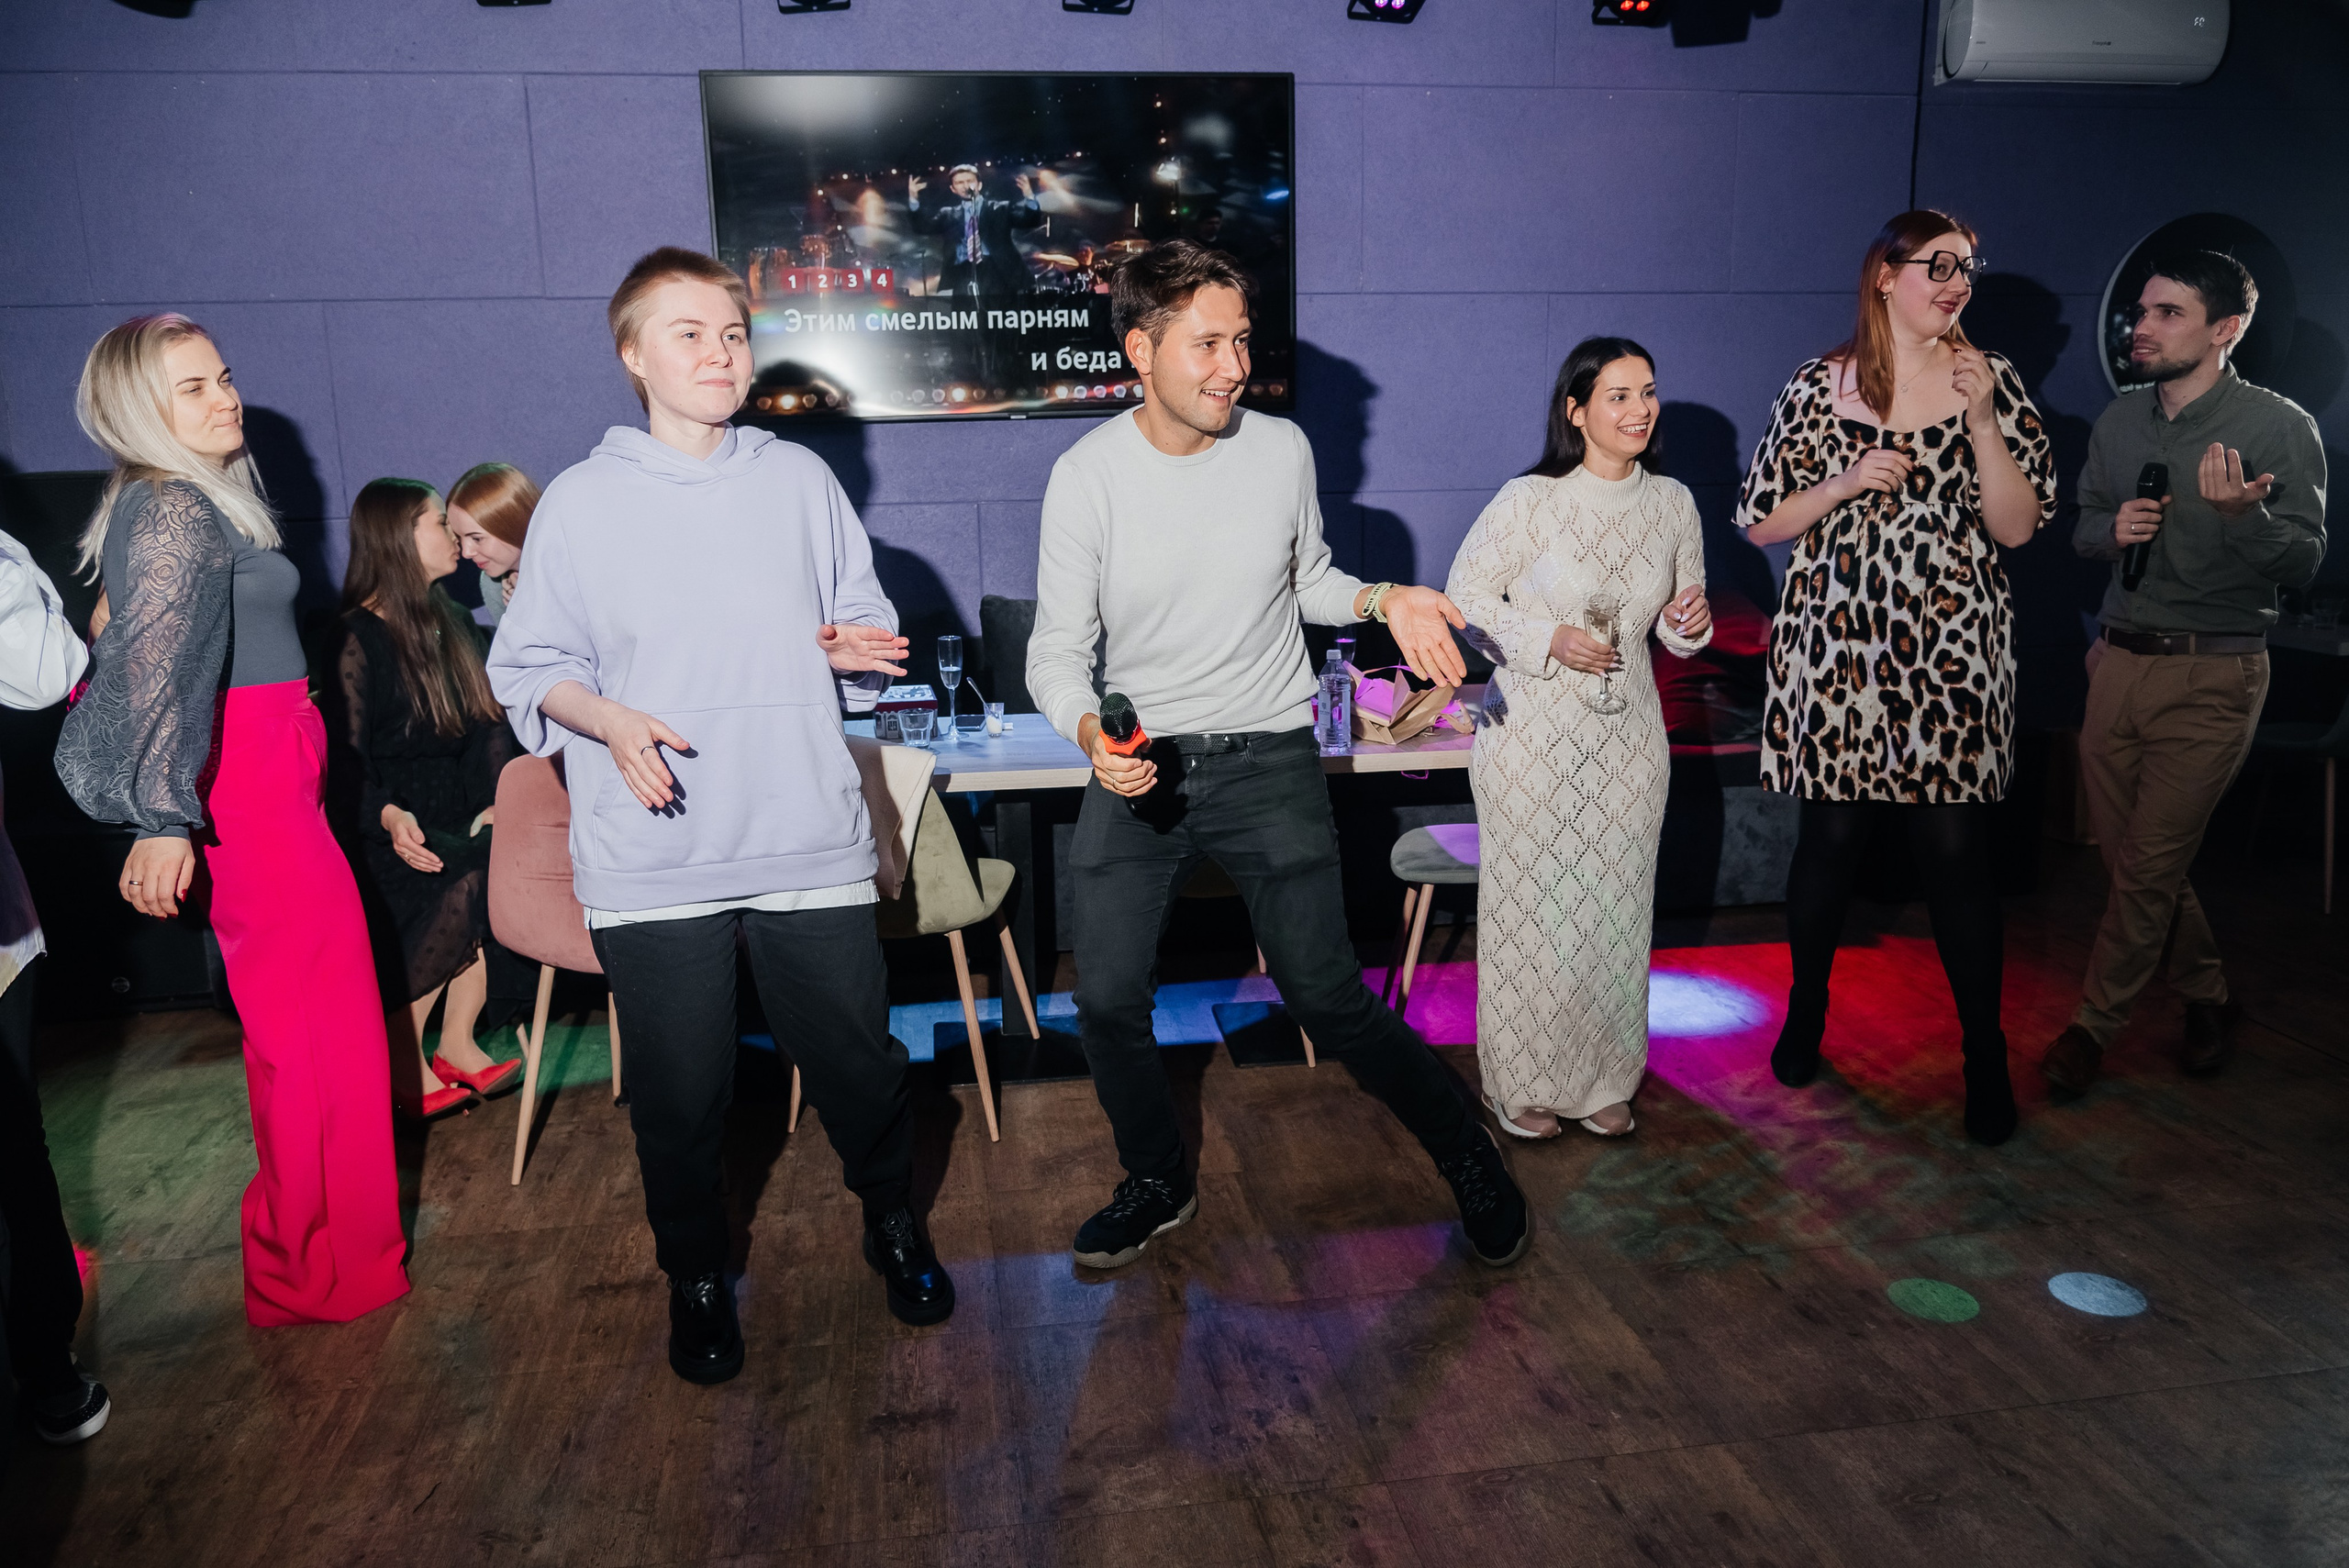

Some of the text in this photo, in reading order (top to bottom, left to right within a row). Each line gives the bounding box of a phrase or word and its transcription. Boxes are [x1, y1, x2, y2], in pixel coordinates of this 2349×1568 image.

[788, 272, 887, 289] 1 2 3 4
[784, 308, 1089, 335] Этим смелым парням
[1031, 346, 1121, 373] и беда
